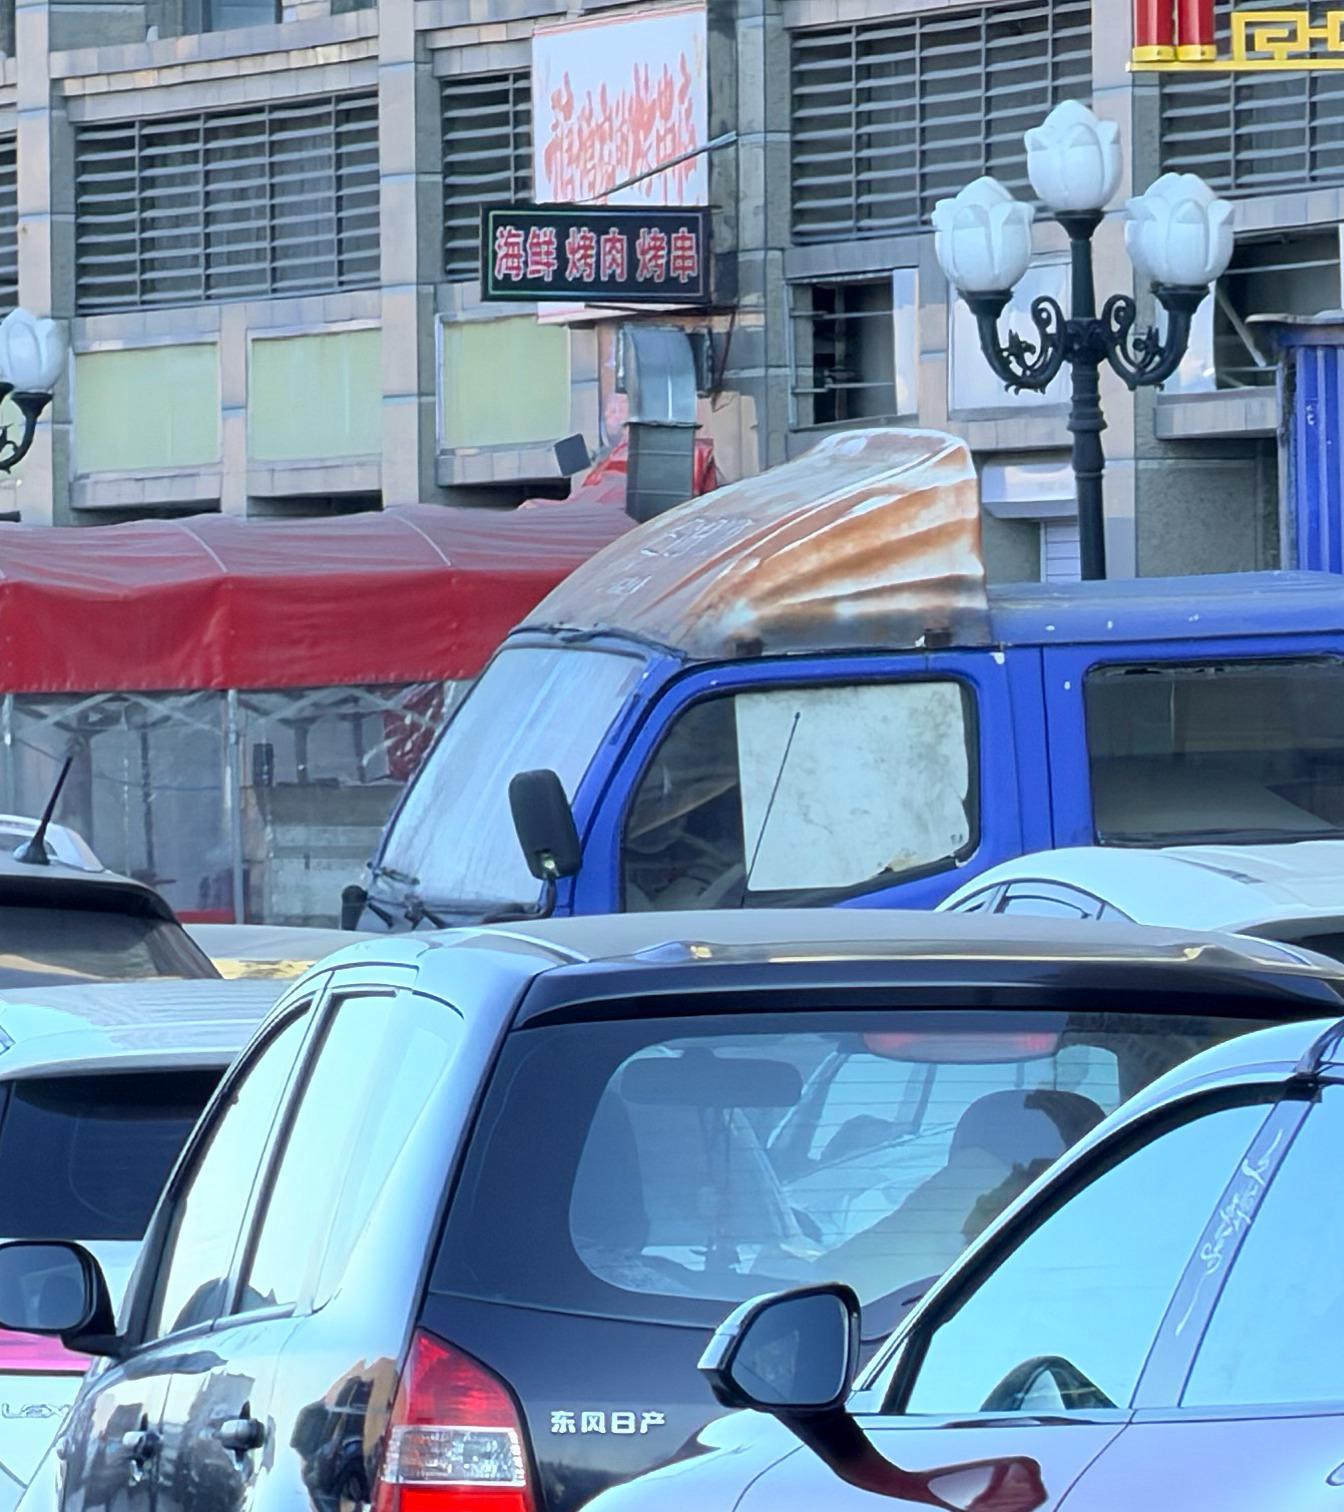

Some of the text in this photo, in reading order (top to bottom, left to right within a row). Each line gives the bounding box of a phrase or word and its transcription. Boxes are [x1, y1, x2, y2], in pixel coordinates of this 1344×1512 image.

[494, 225, 699, 284] 海鲜 烤肉 烤串
[550, 1410, 667, 1435] 东风日产
